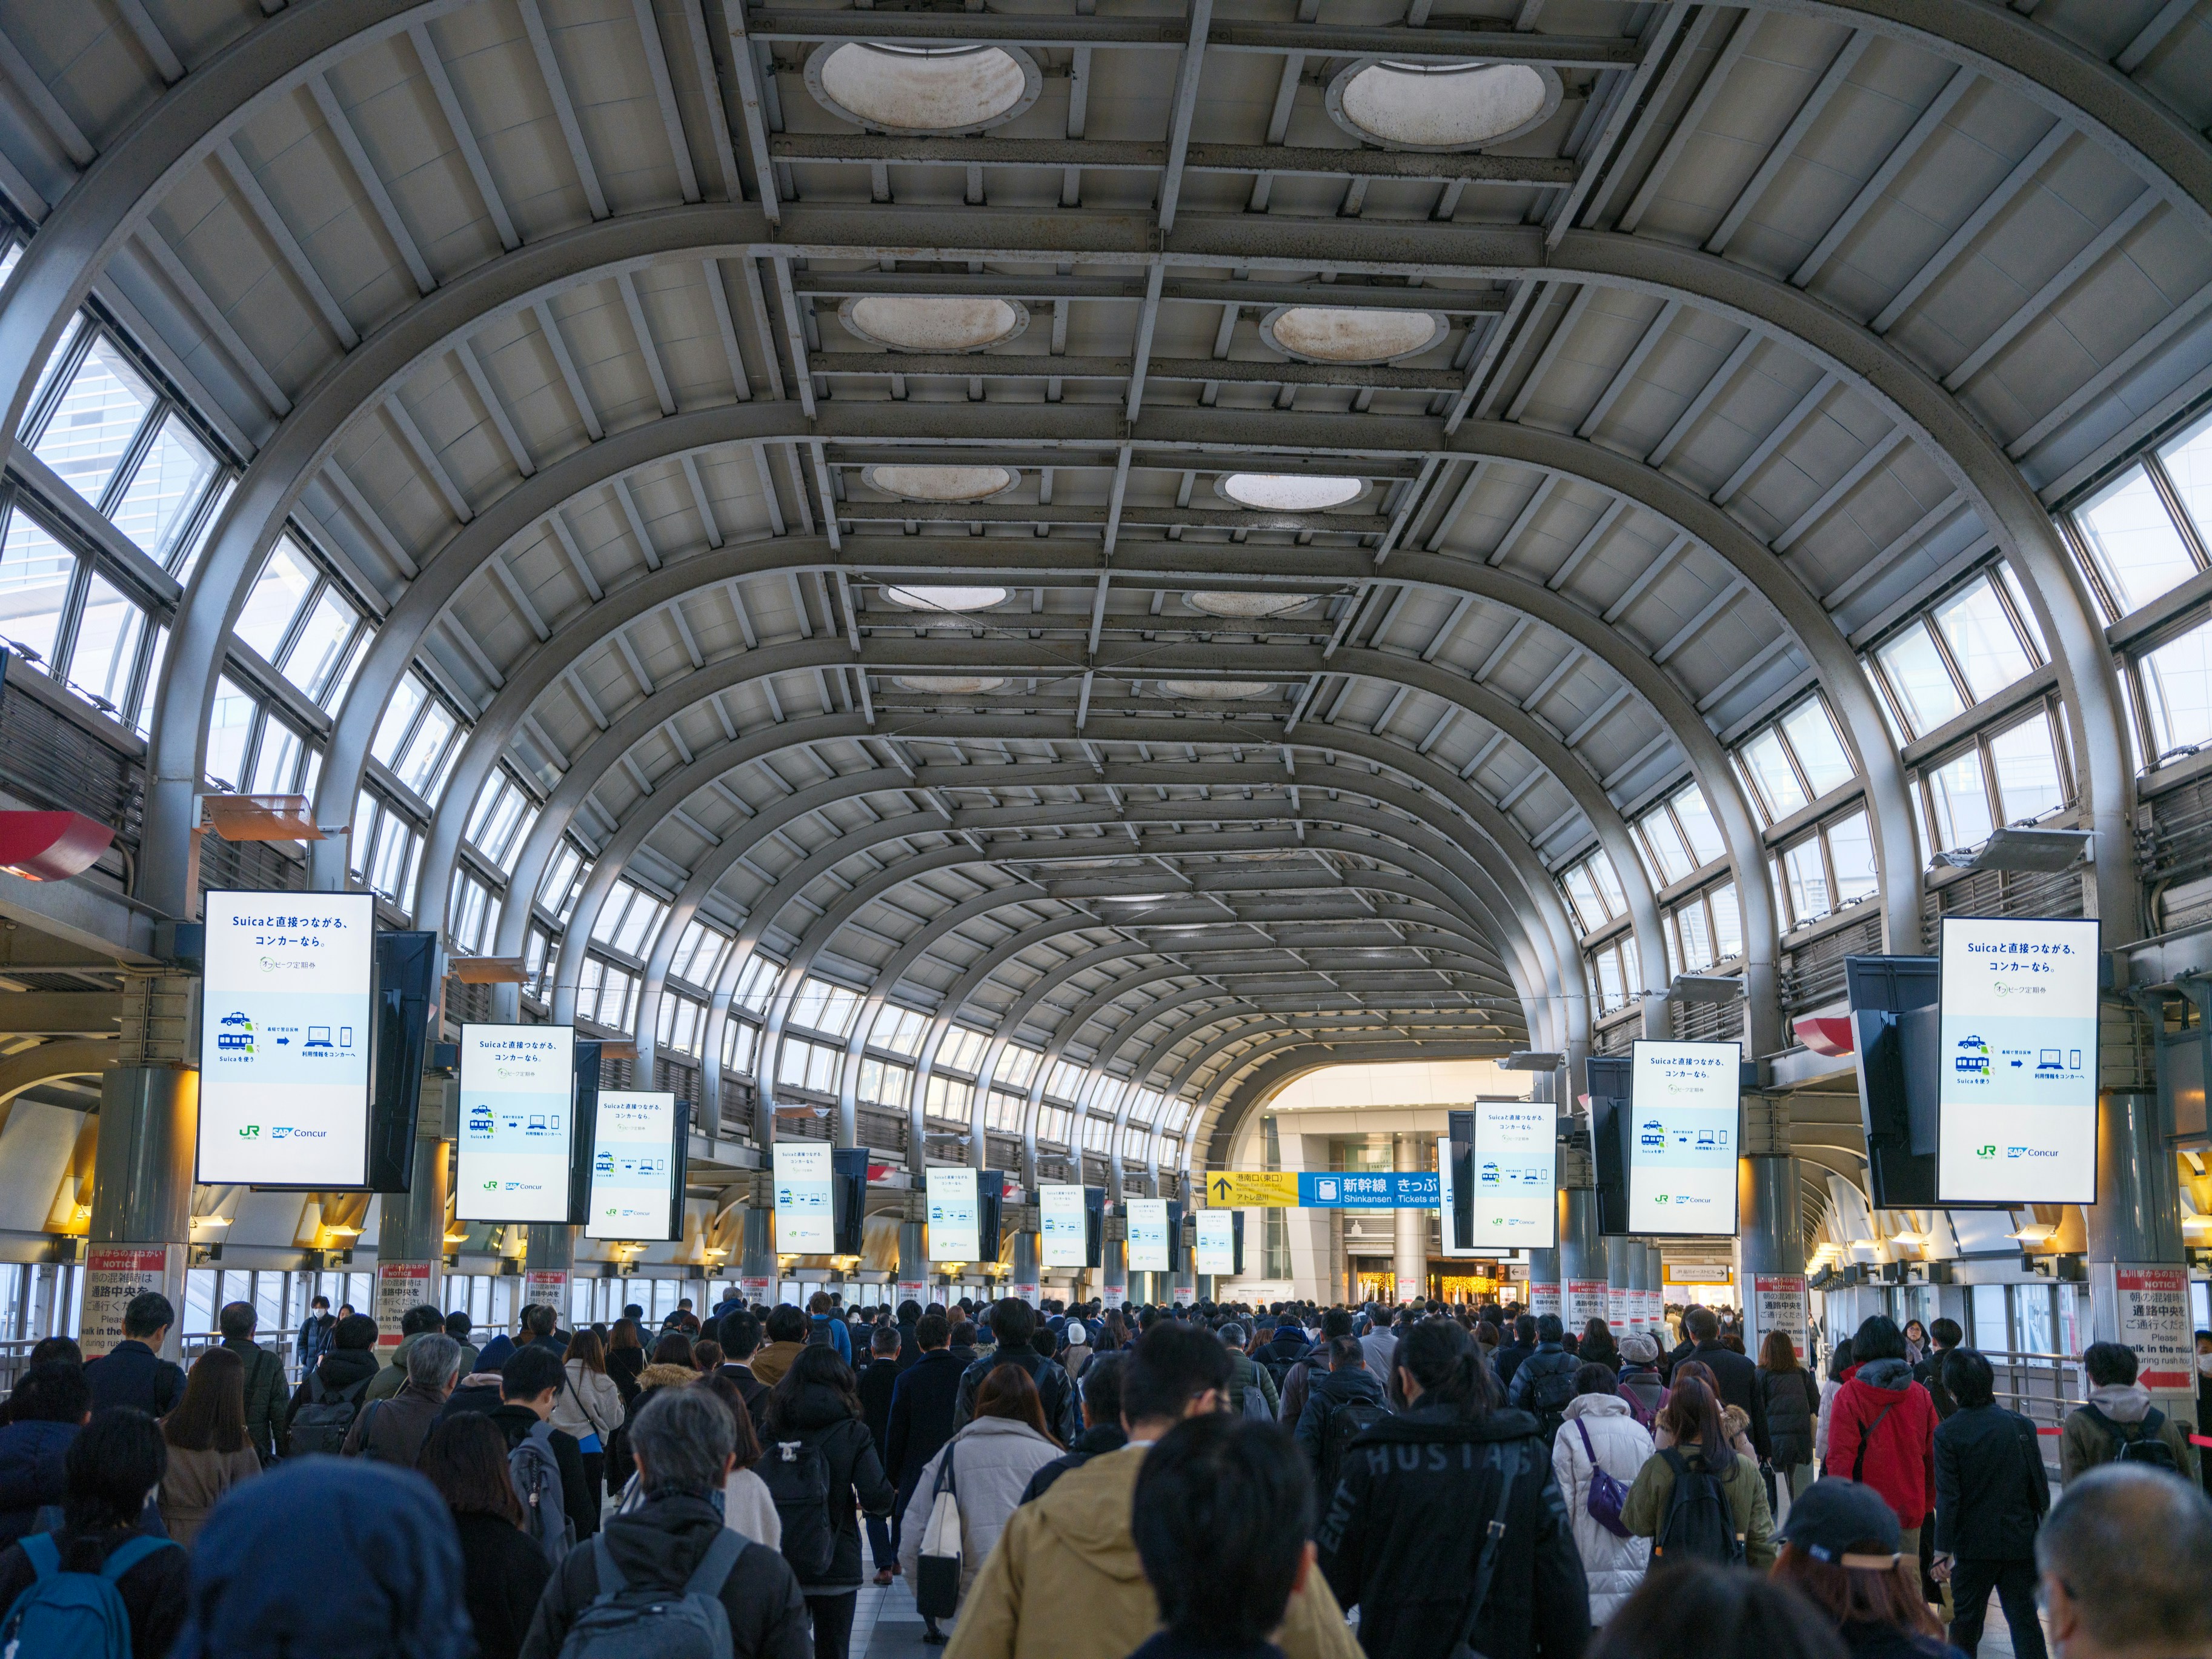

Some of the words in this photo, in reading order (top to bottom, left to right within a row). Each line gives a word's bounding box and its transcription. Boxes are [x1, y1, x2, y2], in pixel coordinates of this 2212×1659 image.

[233, 916, 348, 928] Suicaと直接つながる、
[256, 936, 324, 946] コンカーなら。
[1968, 943, 2075, 954] Suicaと直接つながる、
[1990, 962, 2054, 972] コンカーなら。
[239, 1125, 260, 1136] JR
[273, 1128, 292, 1138] SAP
[1977, 1145, 1996, 1155] JR
[2008, 1147, 2025, 1157] SAP
[1236, 1174, 1283, 1183] 港南口（東口）
[1343, 1178, 1387, 1193] 新幹線
[1397, 1178, 1439, 1193] きっぷ
[1344, 1195, 1392, 1203] Shinkansen
[1398, 1195, 1427, 1203] Tickets
[91, 1272, 153, 1283] 朝の混雑時は
[82, 1327, 95, 1335] walk
[96, 1327, 104, 1335] in
[85, 1340, 105, 1348] during
[2147, 1345, 2157, 1353] in
[2137, 1357, 2160, 1366] uring
